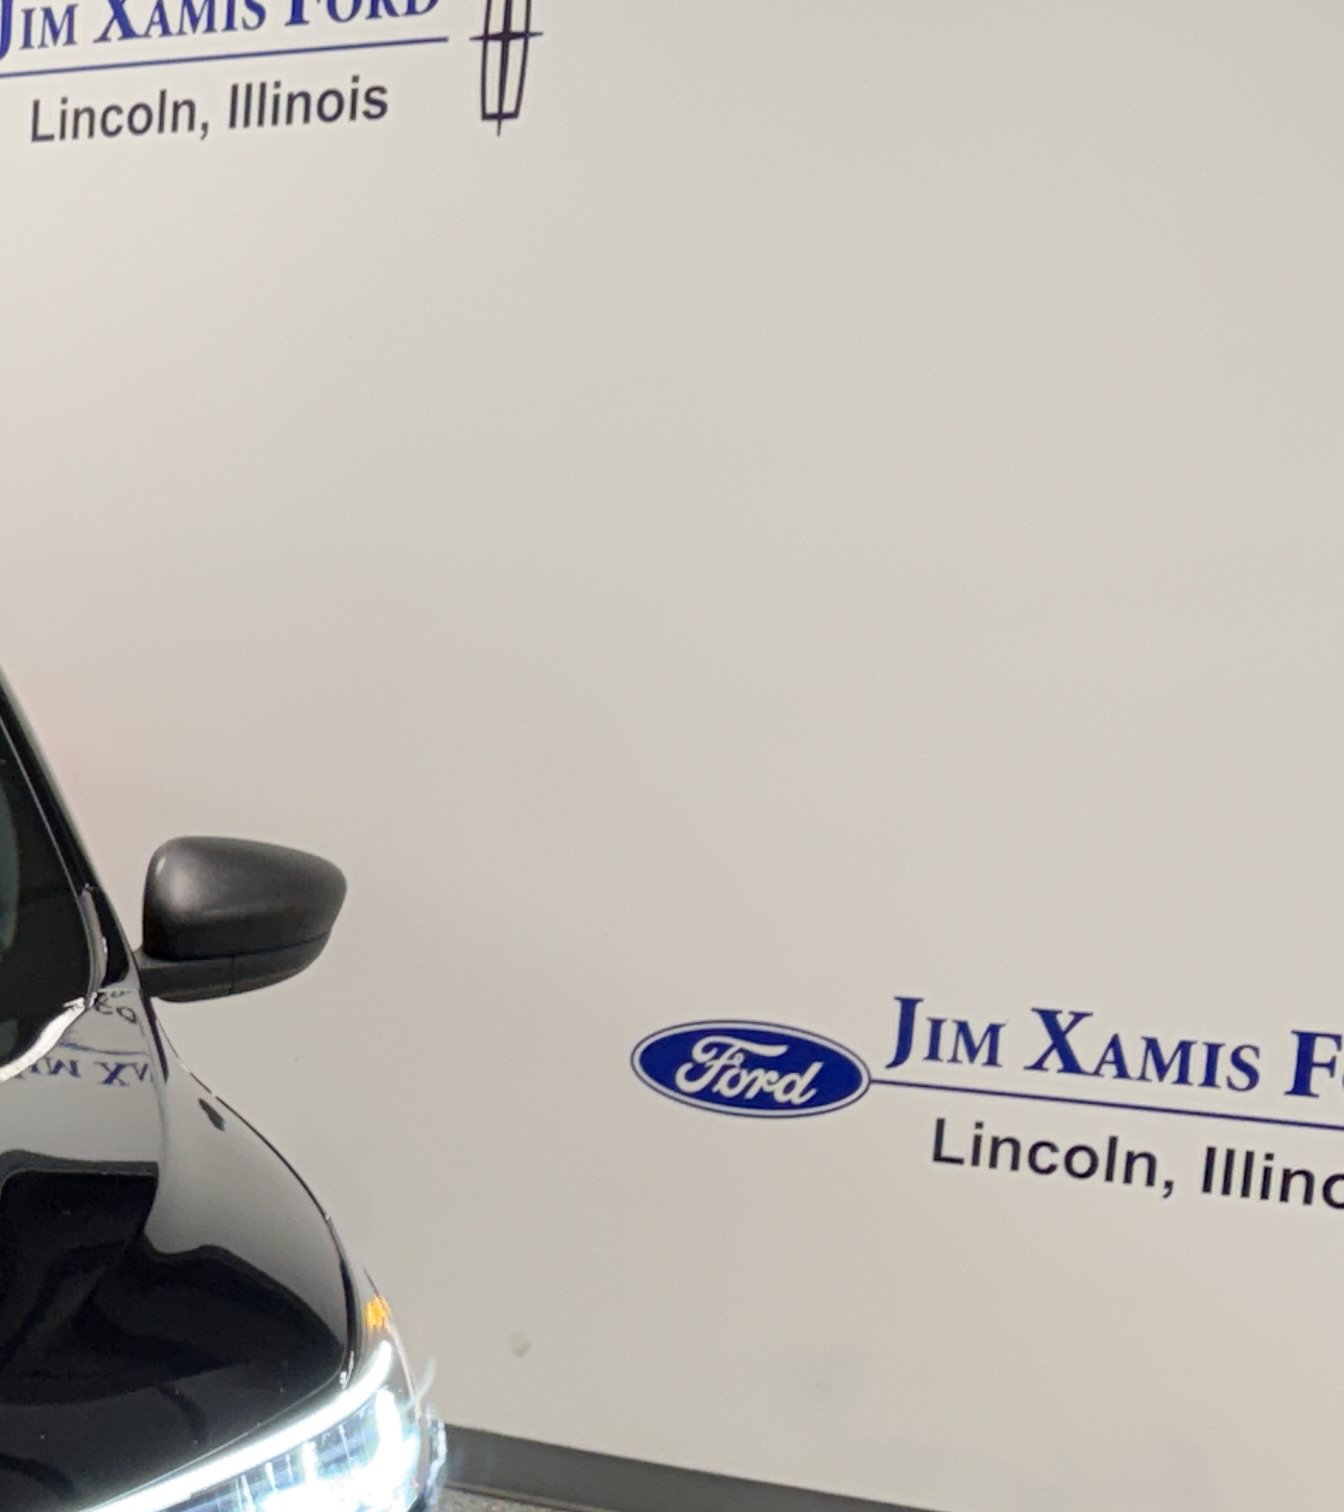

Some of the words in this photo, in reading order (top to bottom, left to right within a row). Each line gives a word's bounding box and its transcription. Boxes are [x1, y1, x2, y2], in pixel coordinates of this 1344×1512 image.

[30, 90, 210, 142] Lincoln,
[228, 75, 390, 129] Illinois
[674, 1034, 819, 1106] Ford
[885, 996, 1008, 1069] JIM
[1024, 1007, 1261, 1092] XAMIS
[932, 1117, 1175, 1199] Lincoln,
